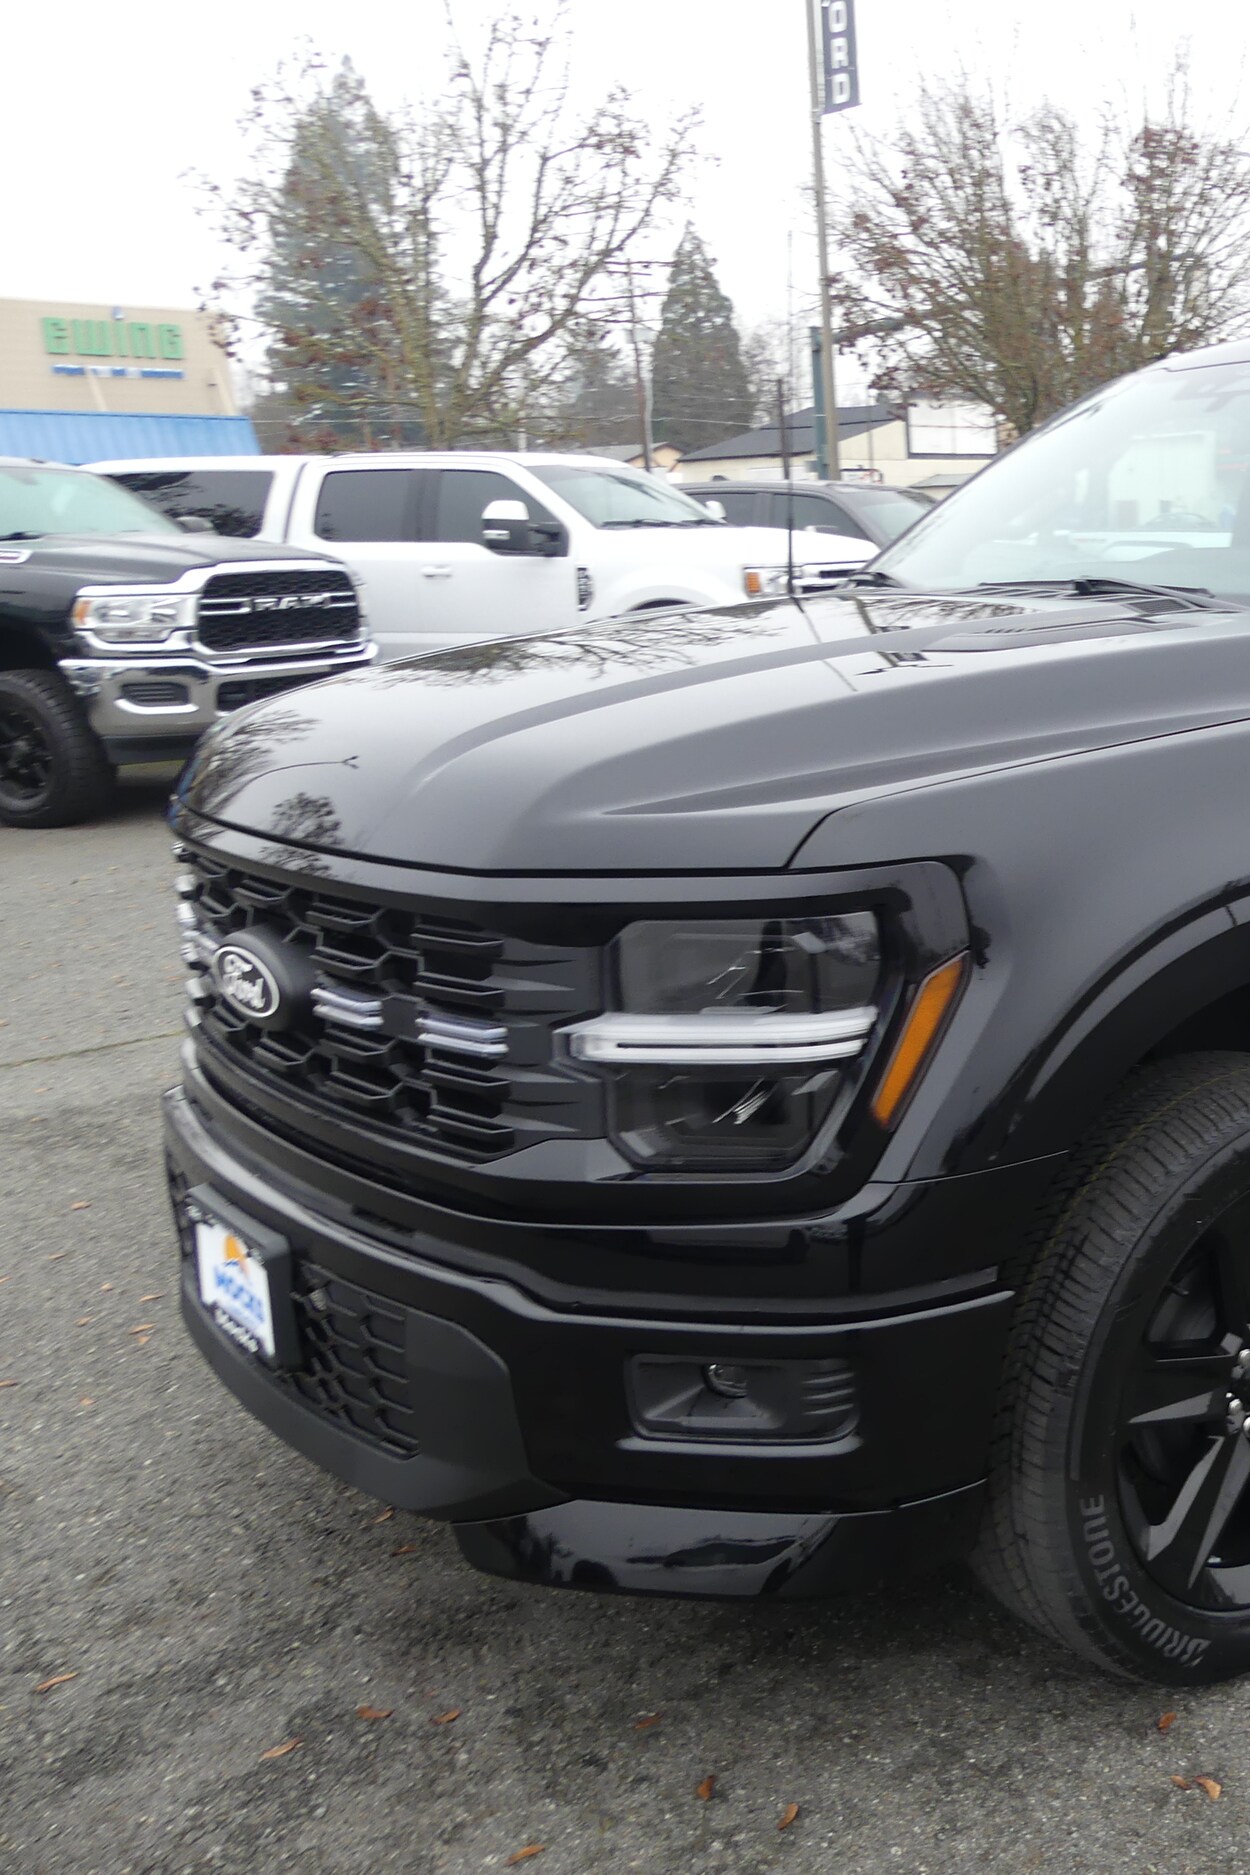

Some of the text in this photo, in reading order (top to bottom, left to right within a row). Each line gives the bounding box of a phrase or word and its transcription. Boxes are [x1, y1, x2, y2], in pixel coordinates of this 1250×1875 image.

[821, 0, 850, 104] ORD
[251, 593, 331, 611] RAM
[223, 952, 266, 1009] Ford
[1080, 1494, 1212, 1667] BRIDGESTONE
